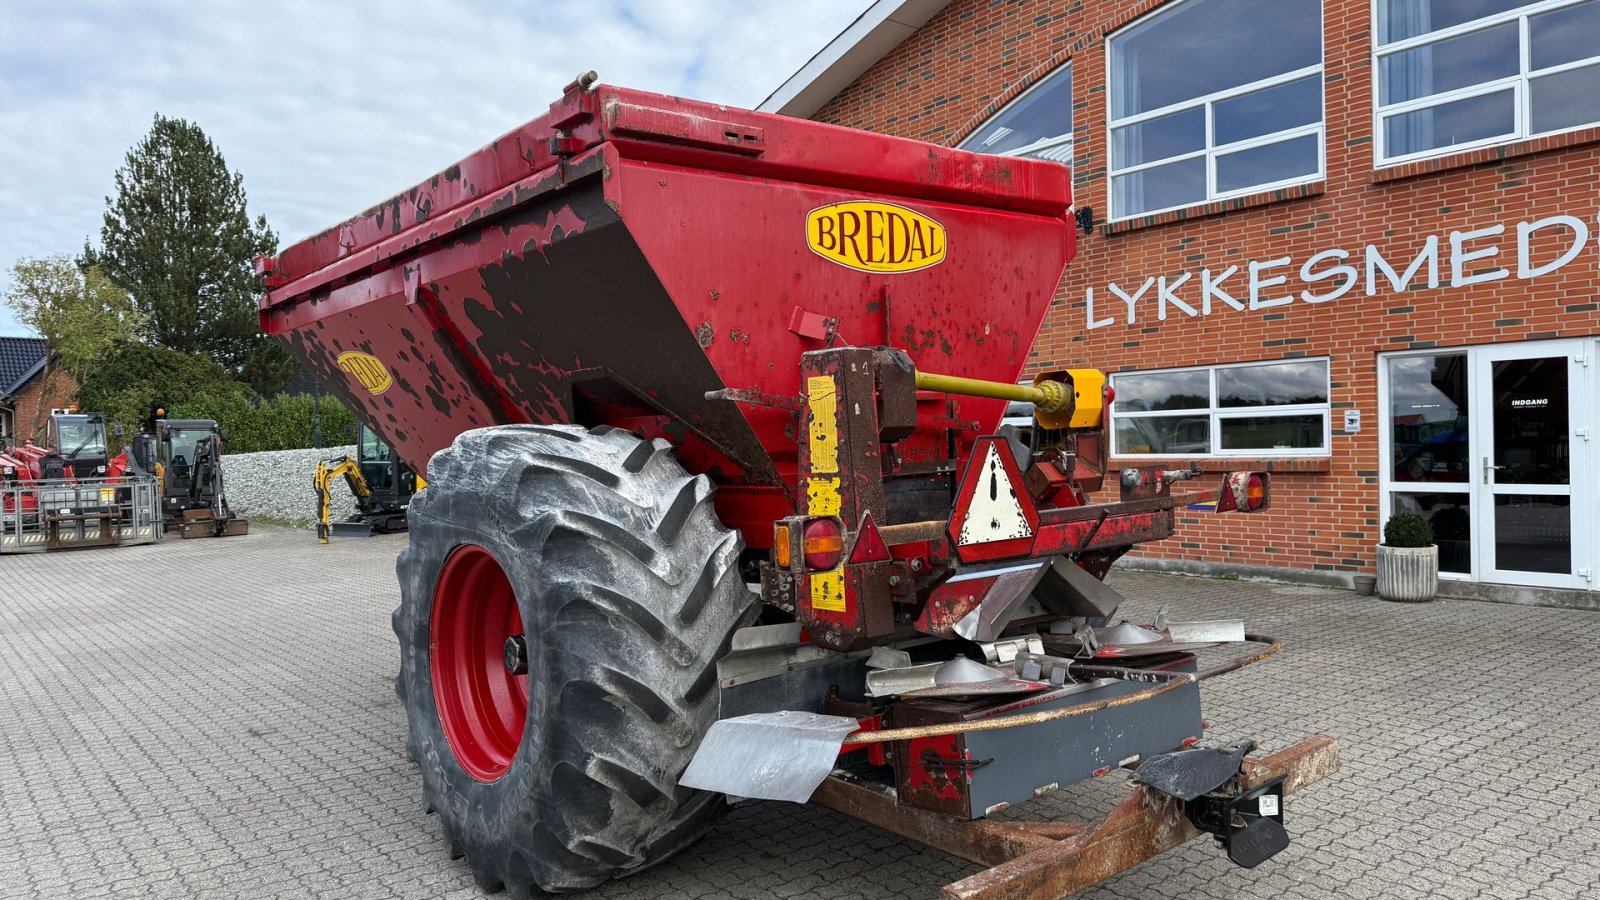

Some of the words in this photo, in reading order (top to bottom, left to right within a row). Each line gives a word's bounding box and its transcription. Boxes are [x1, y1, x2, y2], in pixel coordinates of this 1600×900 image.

[817, 210, 942, 265] BREDAL
[1086, 209, 1600, 329] LYKKESMED
[1511, 398, 1548, 406] INDGANG
